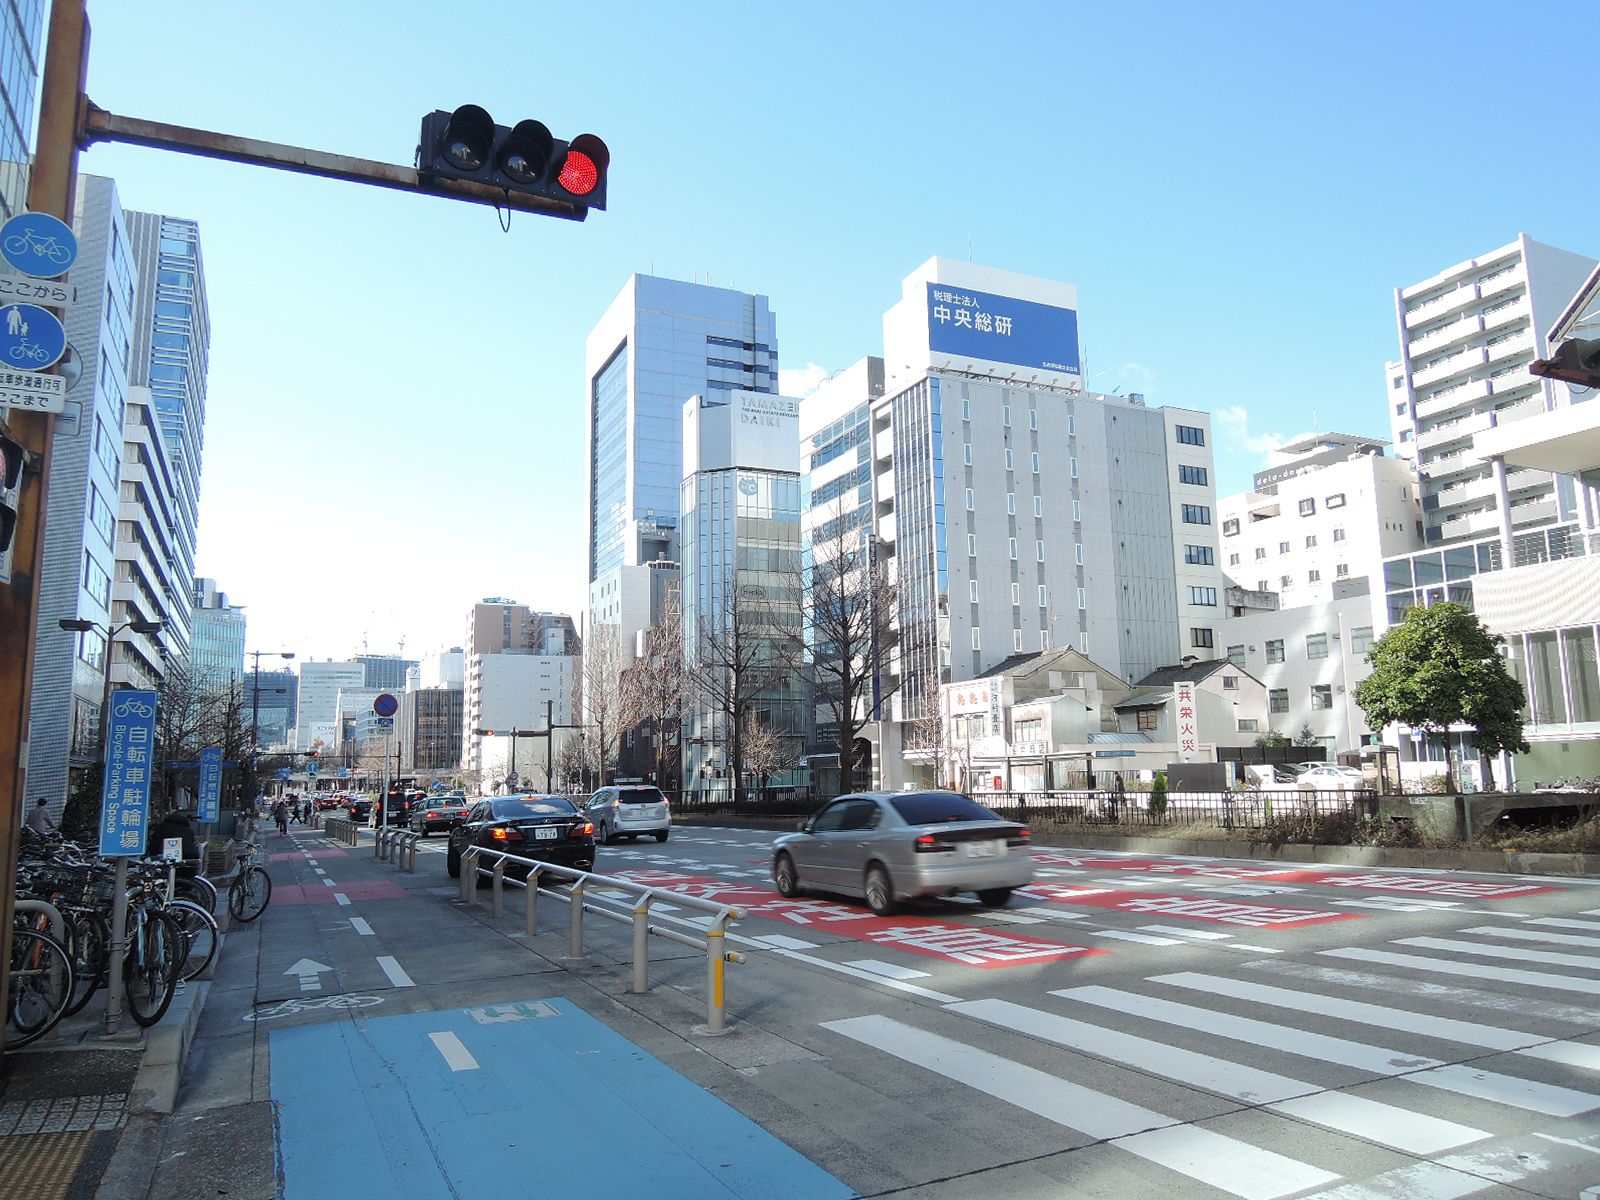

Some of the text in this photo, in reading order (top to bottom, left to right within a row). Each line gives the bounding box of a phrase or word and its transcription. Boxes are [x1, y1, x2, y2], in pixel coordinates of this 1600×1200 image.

[0, 280, 67, 301] ここから
[933, 290, 980, 308] 税理士法人
[933, 304, 1013, 336] 中央総研
[1178, 689, 1195, 753] 共栄火災
[106, 724, 127, 834] Bicycle-Parking Space
[119, 725, 148, 849] 自転車駐輪場
